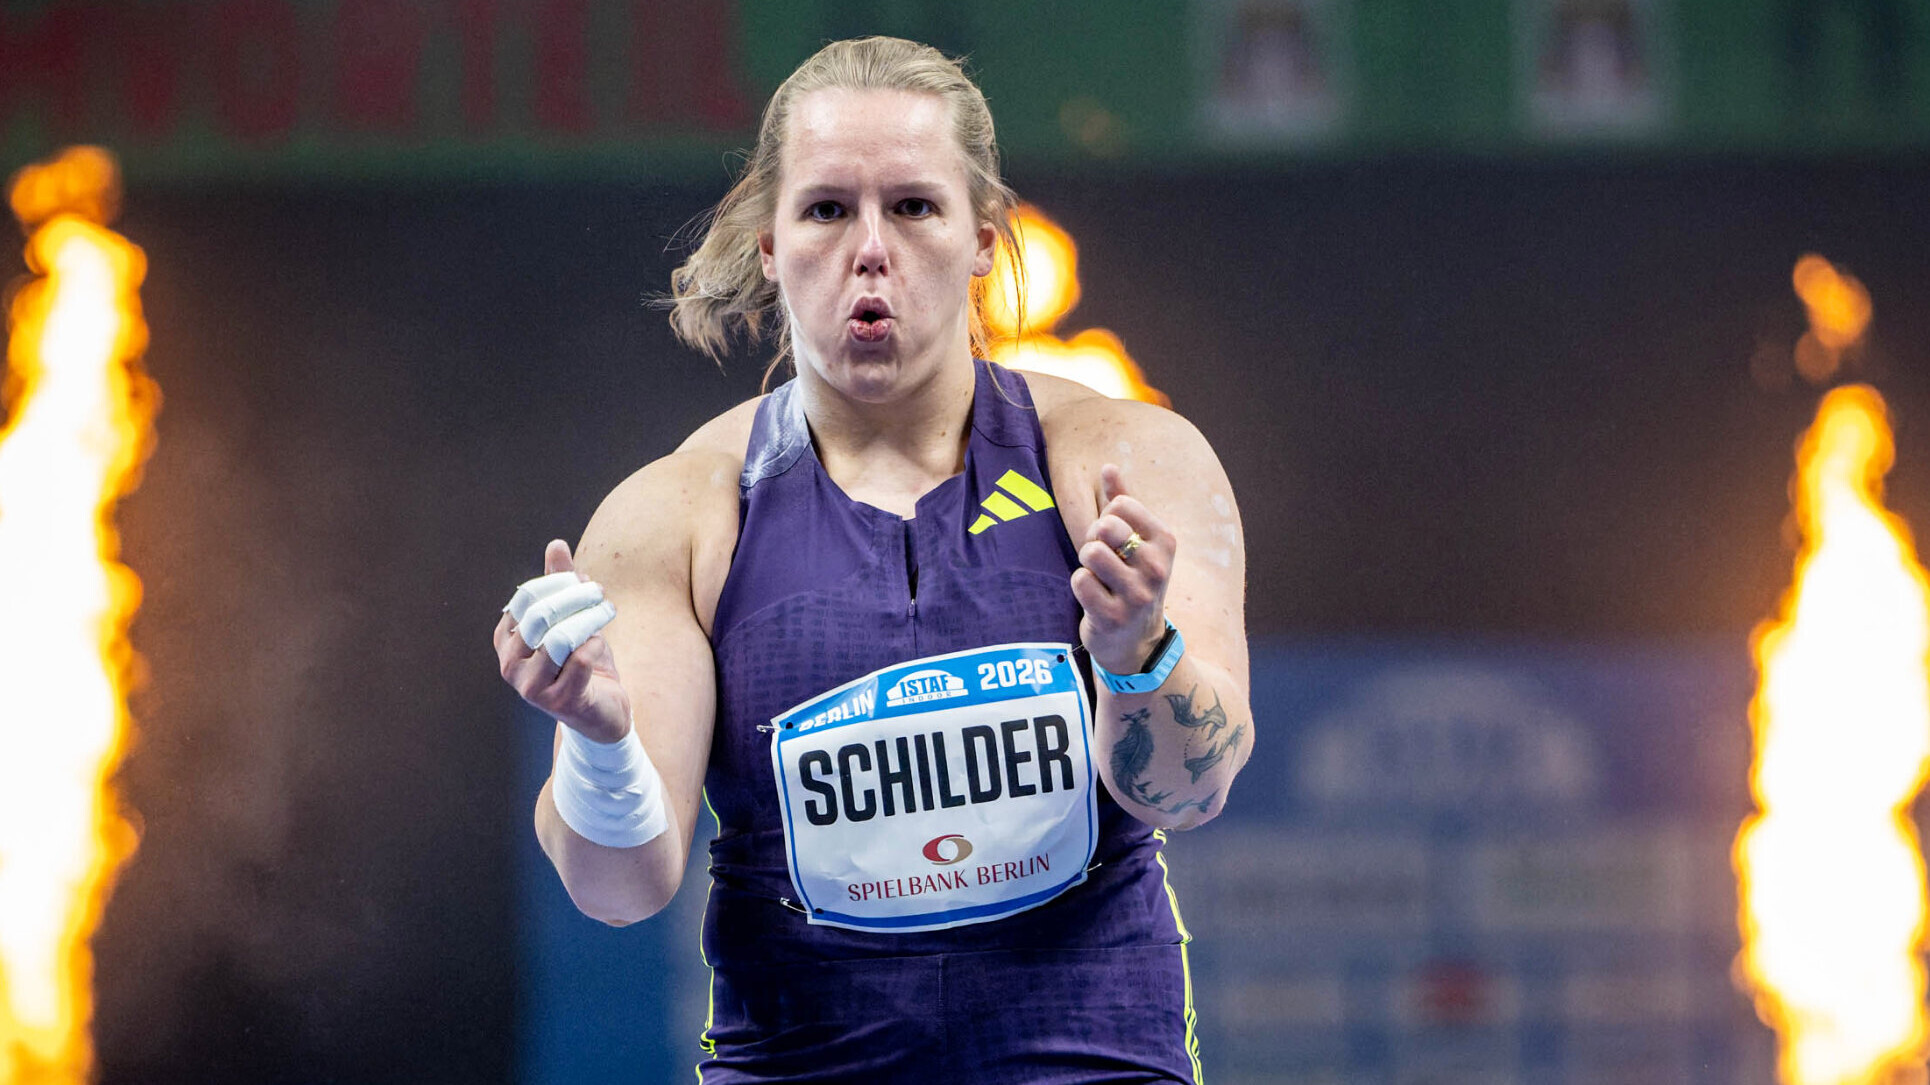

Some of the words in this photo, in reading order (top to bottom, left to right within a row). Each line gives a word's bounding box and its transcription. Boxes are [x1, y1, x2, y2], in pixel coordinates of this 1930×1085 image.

[899, 674, 949, 699] ISTAF
[977, 659, 1053, 690] 2026
[798, 689, 874, 732] BERLIN
[902, 691, 953, 704] INDOOR
[798, 714, 1075, 826] SCHILDER
[847, 868, 969, 902] SPIELBANK
[976, 853, 1051, 886] BERLIN
